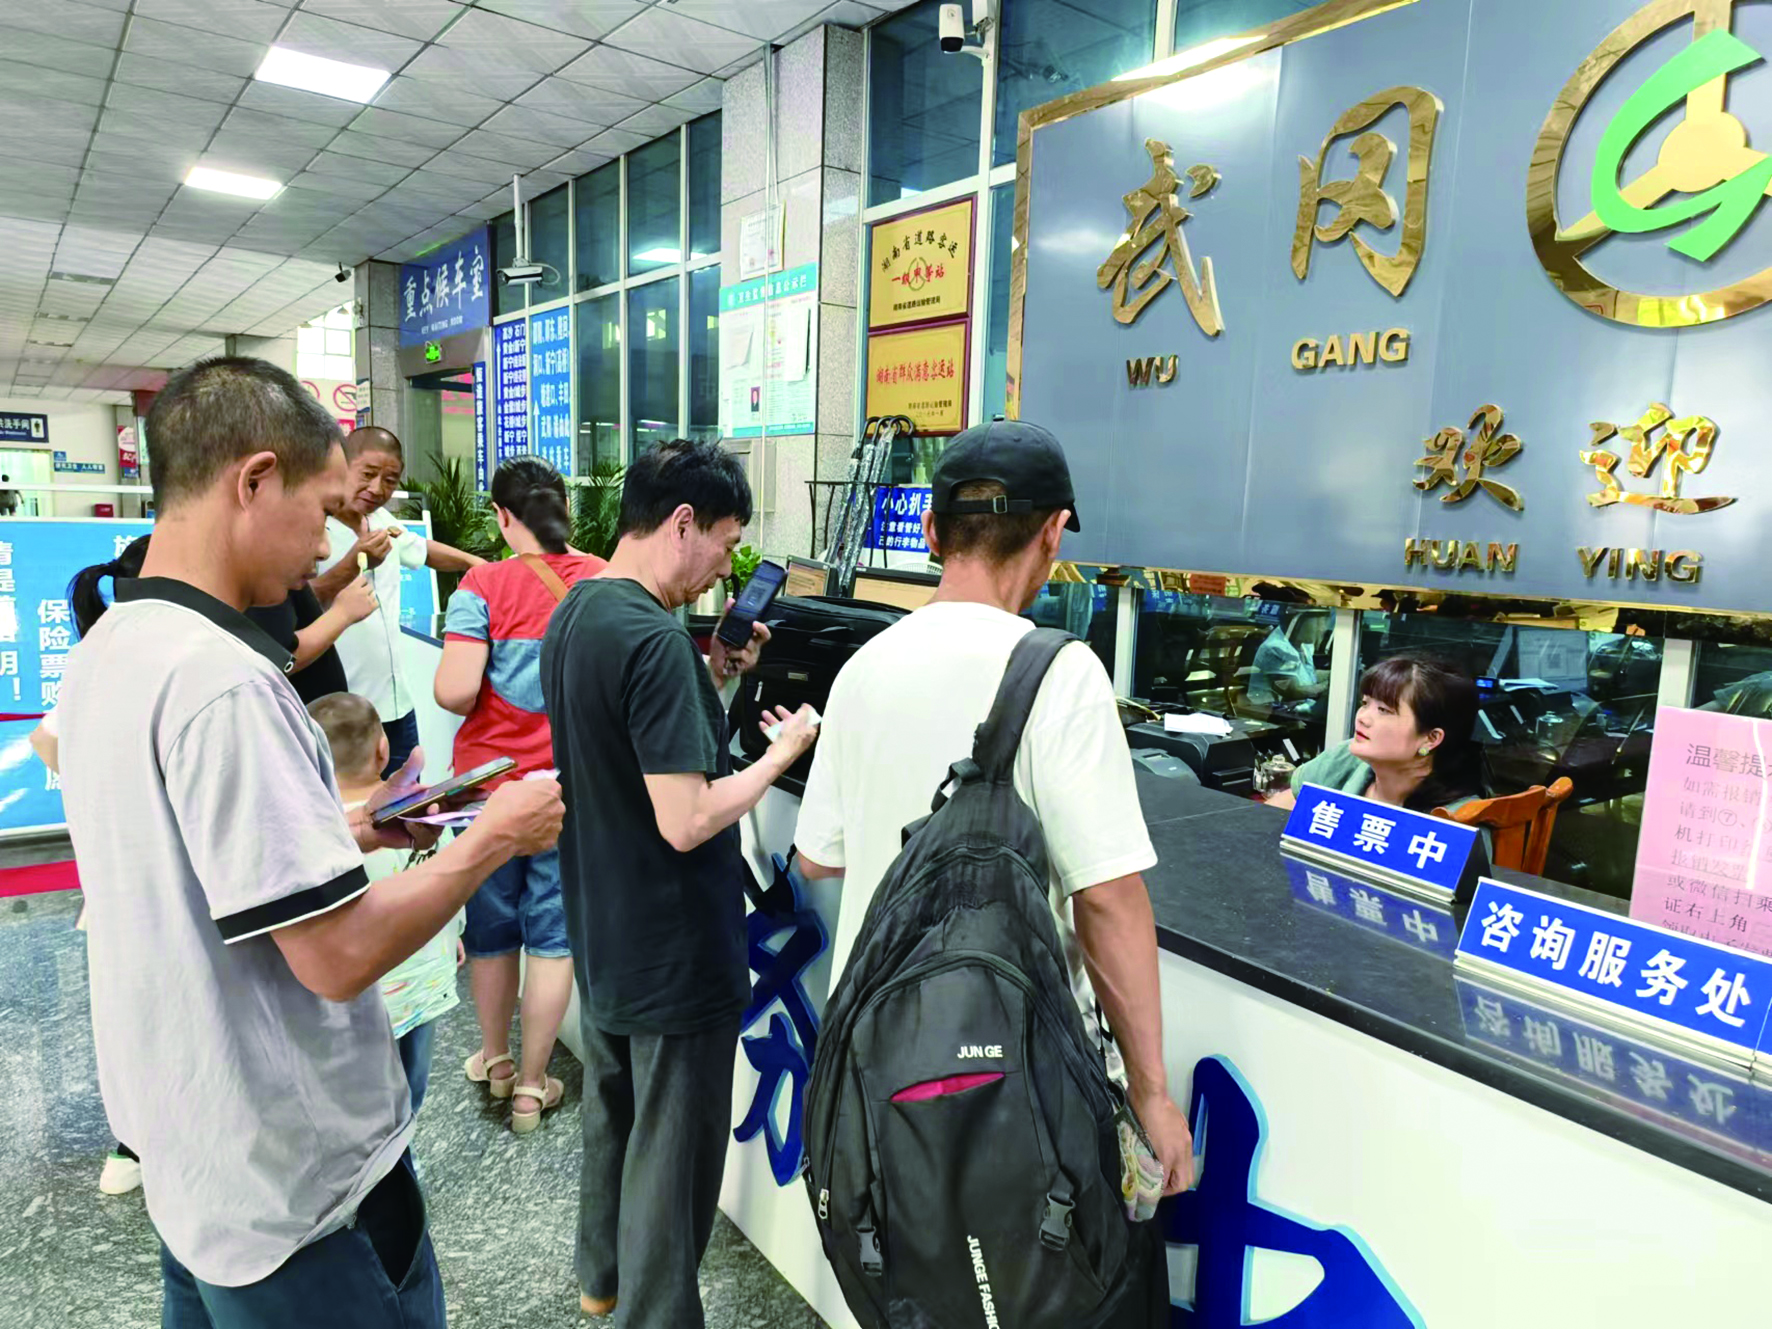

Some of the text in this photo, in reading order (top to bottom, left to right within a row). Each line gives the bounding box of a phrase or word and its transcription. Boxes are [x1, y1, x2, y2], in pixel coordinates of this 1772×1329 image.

[403, 245, 484, 322] 重点候车室
[1126, 326, 1411, 388] WU GANG
[1412, 402, 1739, 515] 欢迎
[881, 521, 924, 534] 意看管好
[1404, 537, 1704, 584] HUAN YING
[1308, 800, 1448, 870] 售票中
[1664, 897, 1747, 932] 证右上角
[1480, 901, 1751, 1028] 咨询服务处
[957, 1044, 1003, 1059] JUN GE
[966, 1234, 989, 1284] JUNGE
